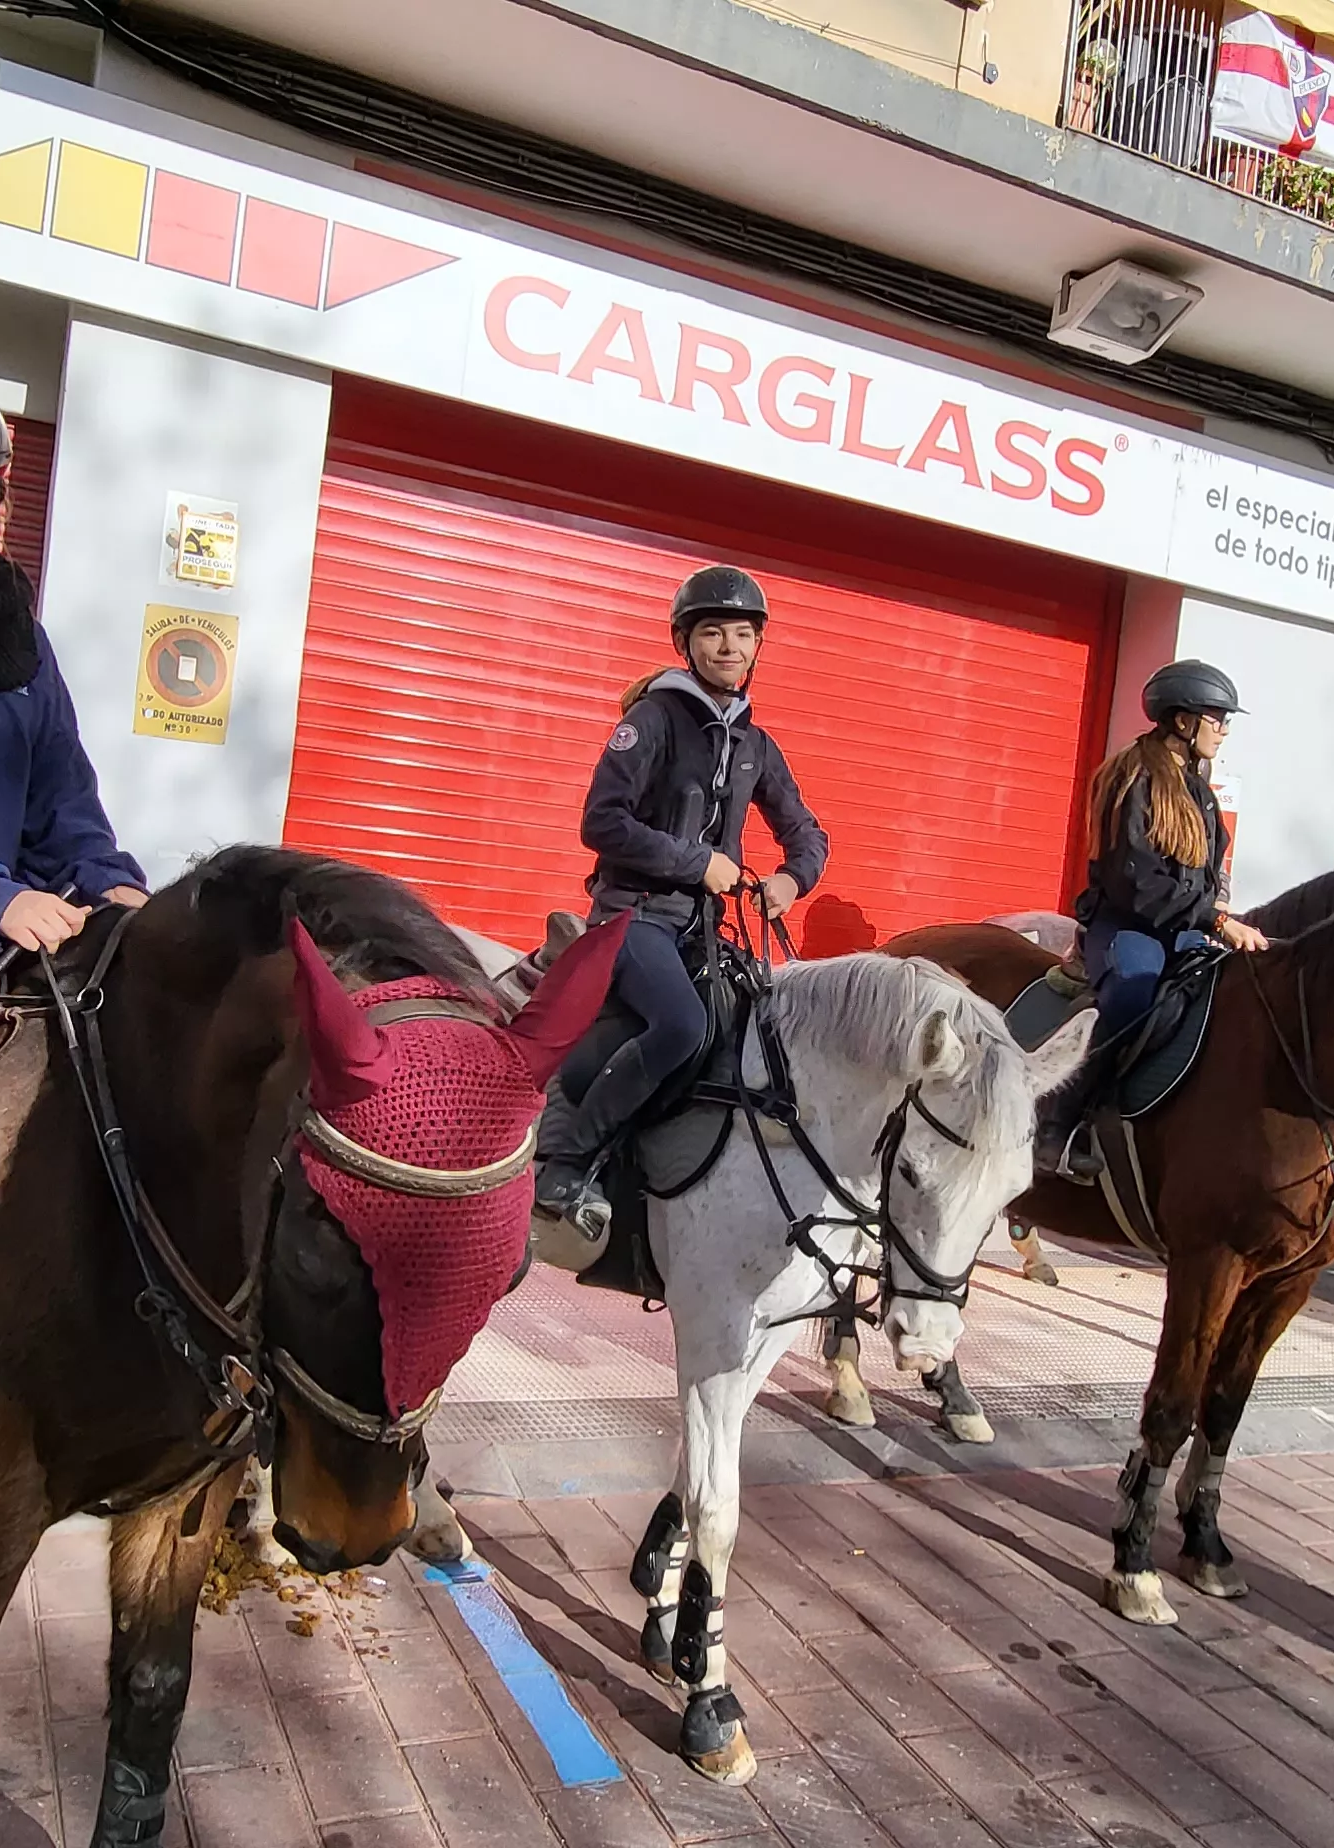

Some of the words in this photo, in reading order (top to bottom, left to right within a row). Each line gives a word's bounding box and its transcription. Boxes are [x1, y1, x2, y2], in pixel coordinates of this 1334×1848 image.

[483, 275, 1107, 516] CARGLASS
[1205, 485, 1228, 511] el
[1214, 529, 1247, 558] de
[1255, 537, 1309, 575] todo
[145, 617, 173, 638] SALIDA
[179, 615, 190, 624] DE
[197, 617, 235, 651] VEHICULOS
[142, 708, 165, 718] VDO
[168, 711, 223, 727] AUTORIZADO
